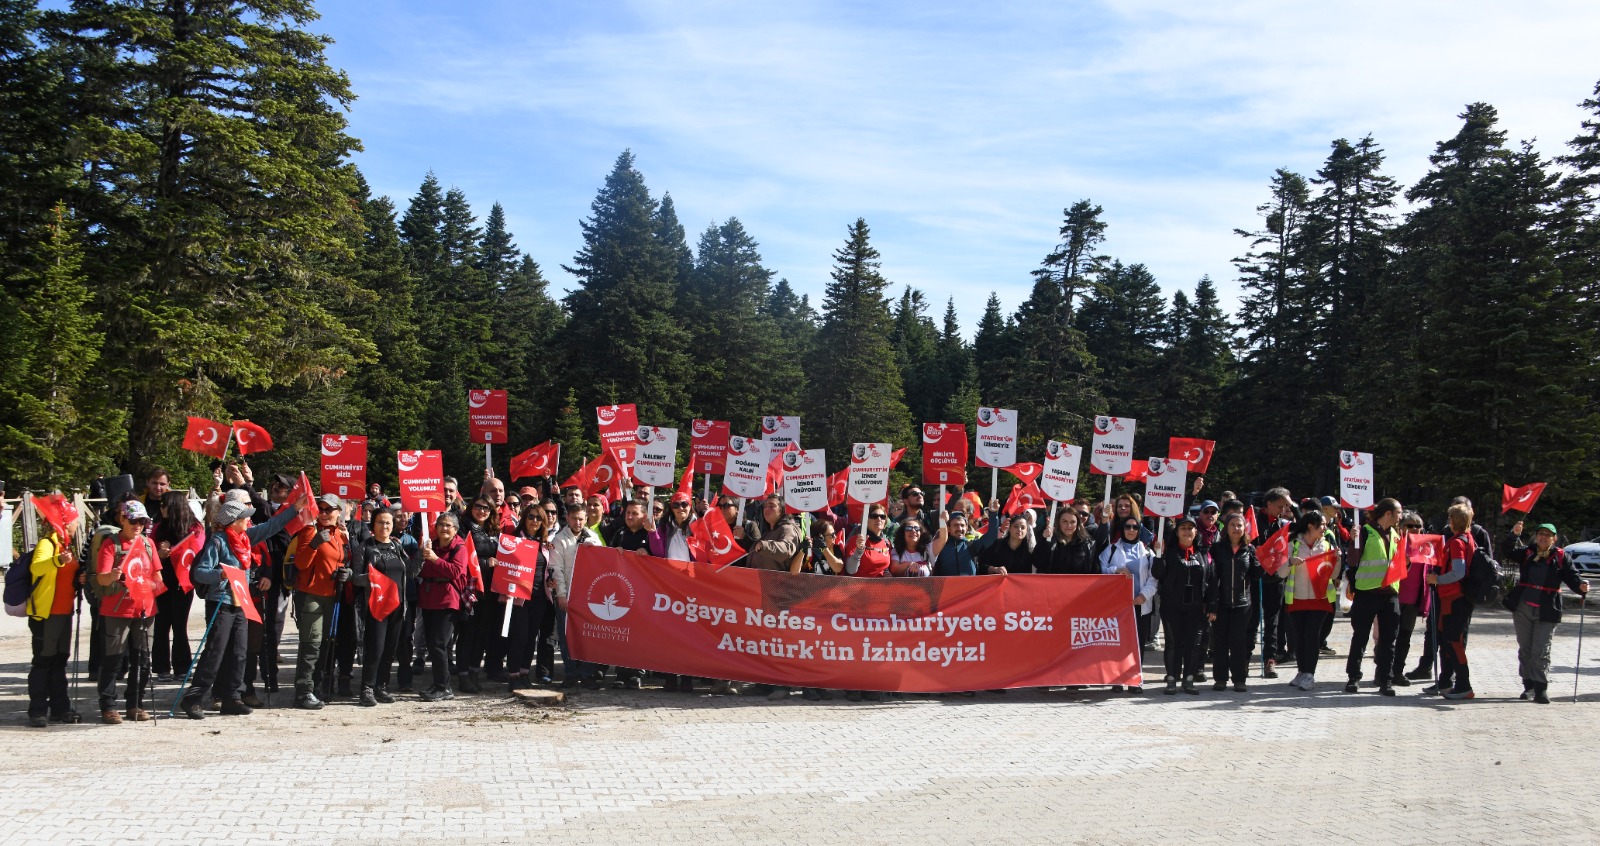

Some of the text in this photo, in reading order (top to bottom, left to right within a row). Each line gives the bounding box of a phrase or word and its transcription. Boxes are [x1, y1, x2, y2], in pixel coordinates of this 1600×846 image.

[652, 592, 1054, 638] Doğaya Nefes, Cumhuriyete Söz:
[1071, 617, 1118, 630] ERKAN
[1073, 629, 1118, 644] AYDIN
[717, 632, 986, 667] Atatürk'ün İzindeyiz!
